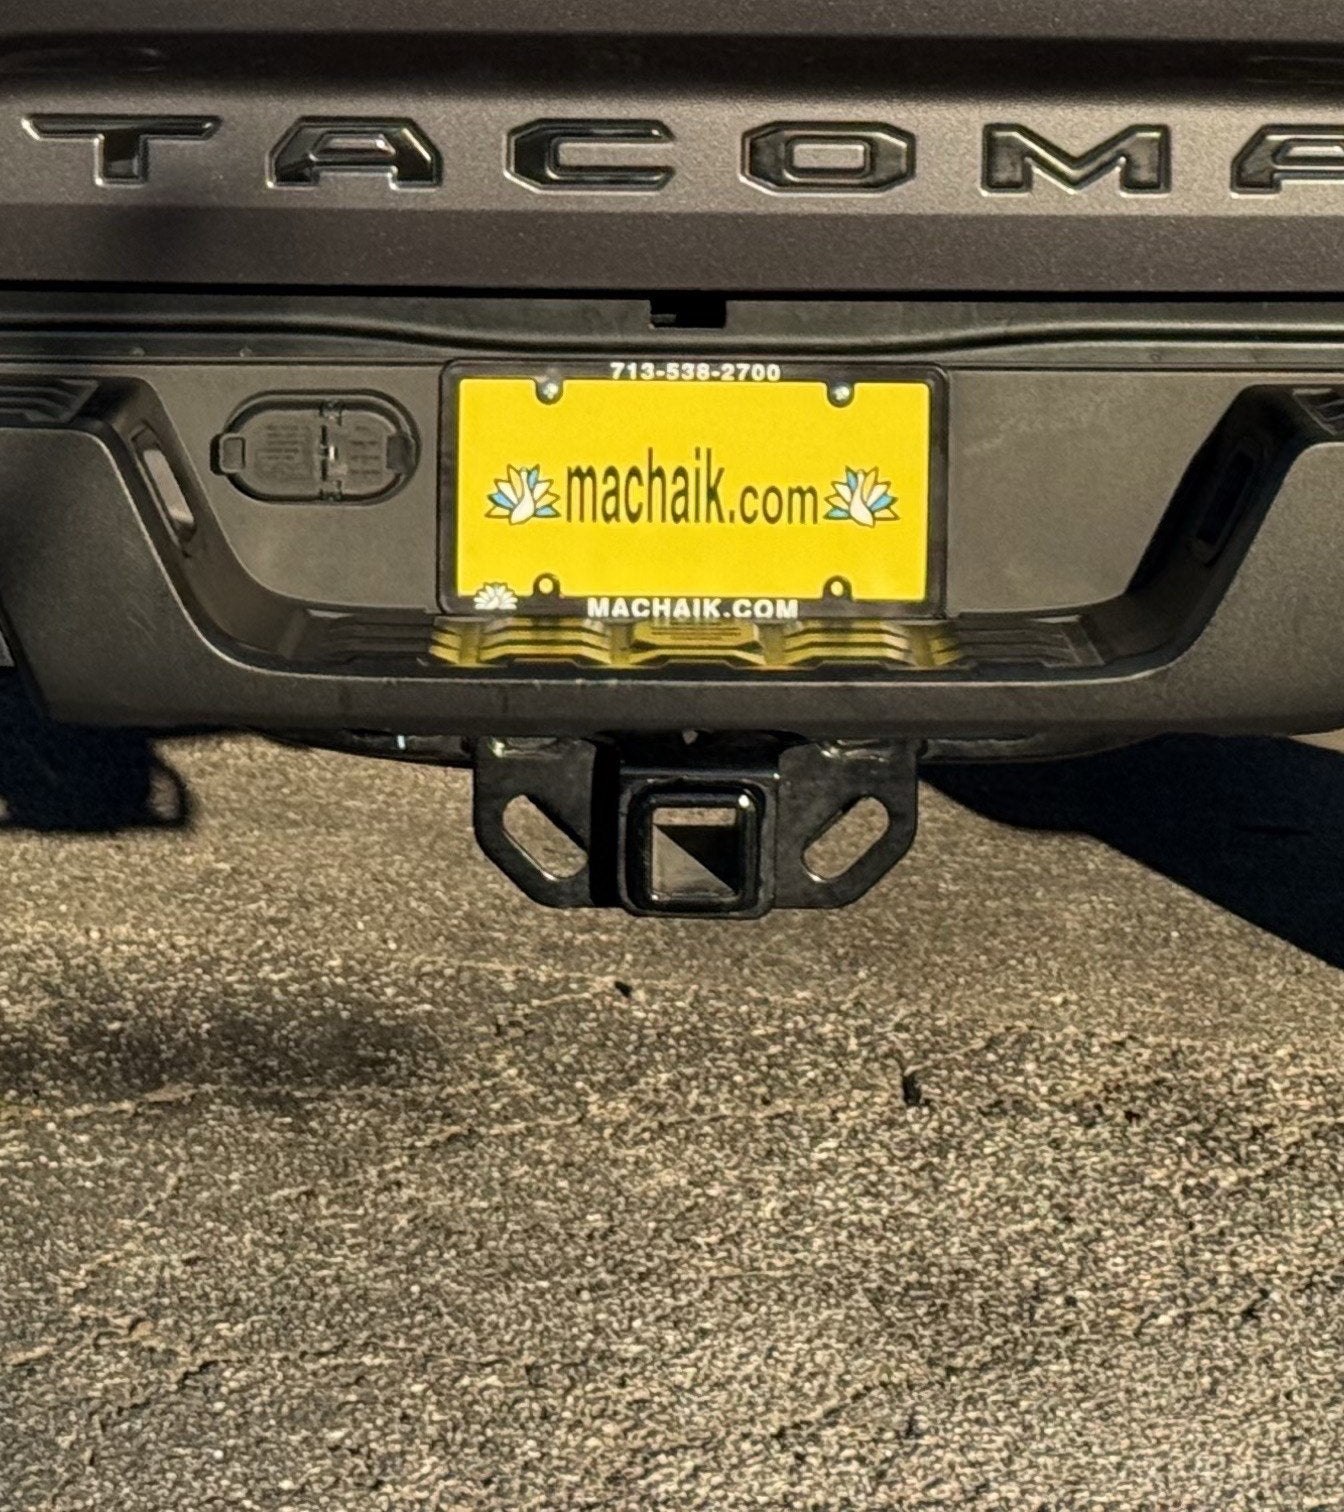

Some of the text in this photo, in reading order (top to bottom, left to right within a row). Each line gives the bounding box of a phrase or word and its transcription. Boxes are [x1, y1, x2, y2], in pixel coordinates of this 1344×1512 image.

[609, 362, 782, 382] 713-538-2700
[565, 446, 820, 525] machaik.com
[586, 598, 799, 620] MACHAIK.COM
